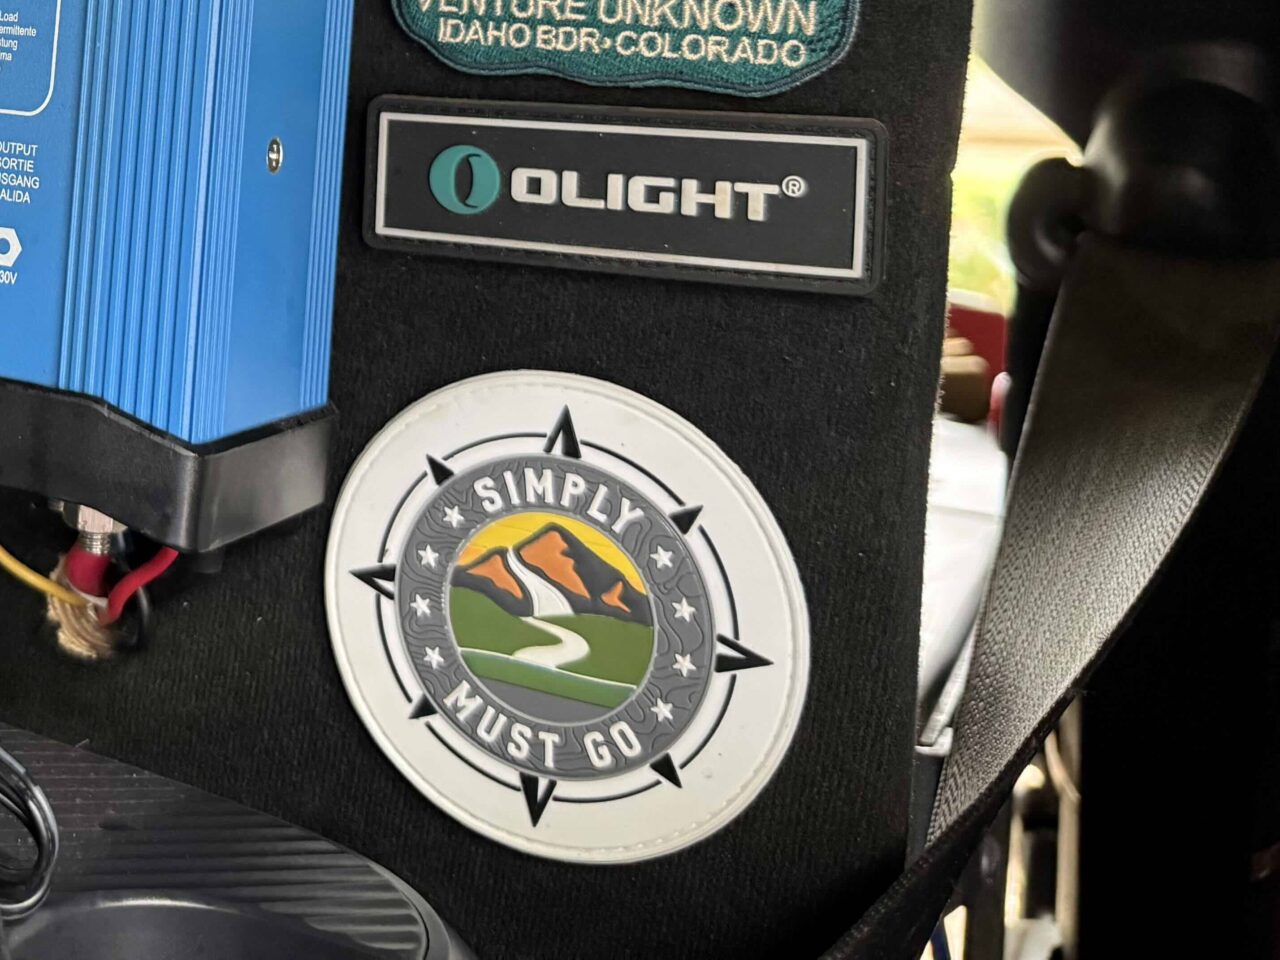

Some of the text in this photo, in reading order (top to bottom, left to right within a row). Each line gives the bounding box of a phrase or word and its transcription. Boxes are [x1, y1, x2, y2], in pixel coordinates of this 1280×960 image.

[0, 10, 19, 22] Load
[438, 16, 532, 50] IDAHO
[474, 466, 646, 535] SIMPLY
[442, 679, 642, 770] MUST GO
